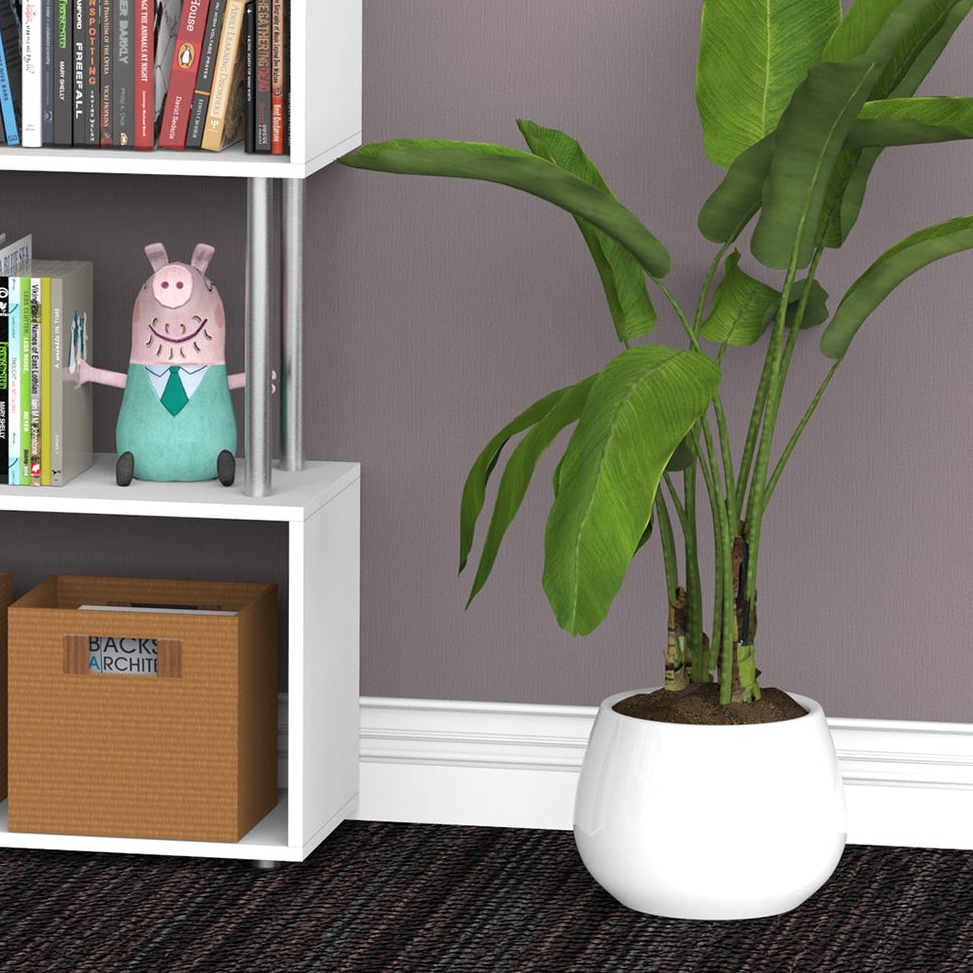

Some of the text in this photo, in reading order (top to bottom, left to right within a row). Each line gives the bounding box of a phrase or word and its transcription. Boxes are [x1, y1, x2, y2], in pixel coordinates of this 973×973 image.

[140, 12, 148, 24] THE
[140, 24, 148, 52] ANIMALS
[207, 28, 215, 55] VOLTAGE
[258, 12, 269, 67] GATHERING
[140, 53, 148, 62] AT
[203, 56, 211, 79] PRAYER
[75, 42, 83, 119] FREEFALL
[140, 62, 148, 83] NIGHT
[31, 324, 39, 346] Names
[31, 355, 39, 369] East
[31, 370, 39, 394] Lothian
